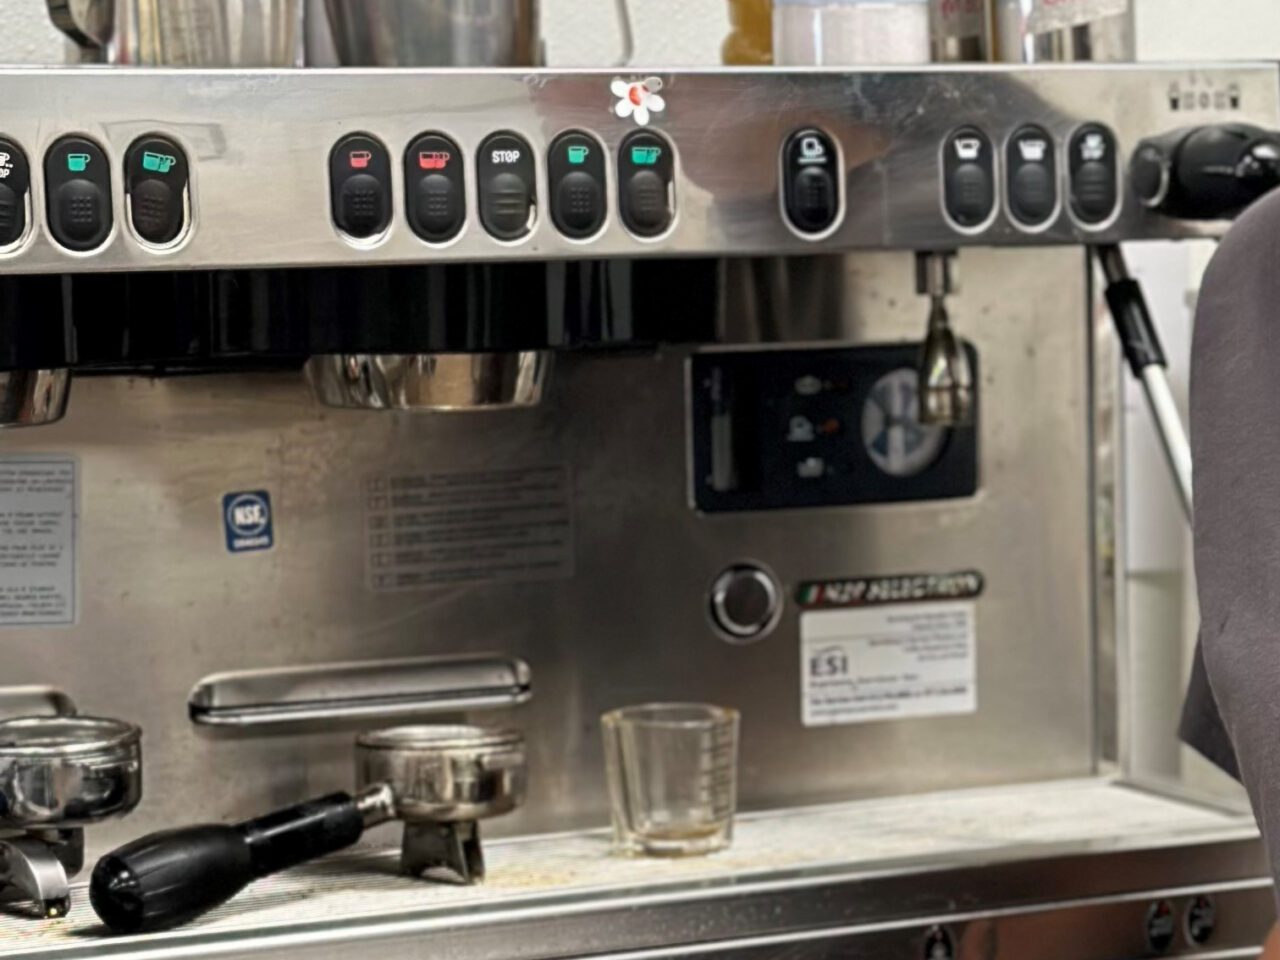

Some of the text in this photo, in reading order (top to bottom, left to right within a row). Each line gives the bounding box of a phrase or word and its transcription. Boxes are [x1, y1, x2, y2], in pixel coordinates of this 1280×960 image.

[491, 150, 521, 164] STOP
[234, 504, 261, 526] NSF
[809, 654, 848, 678] ESI
